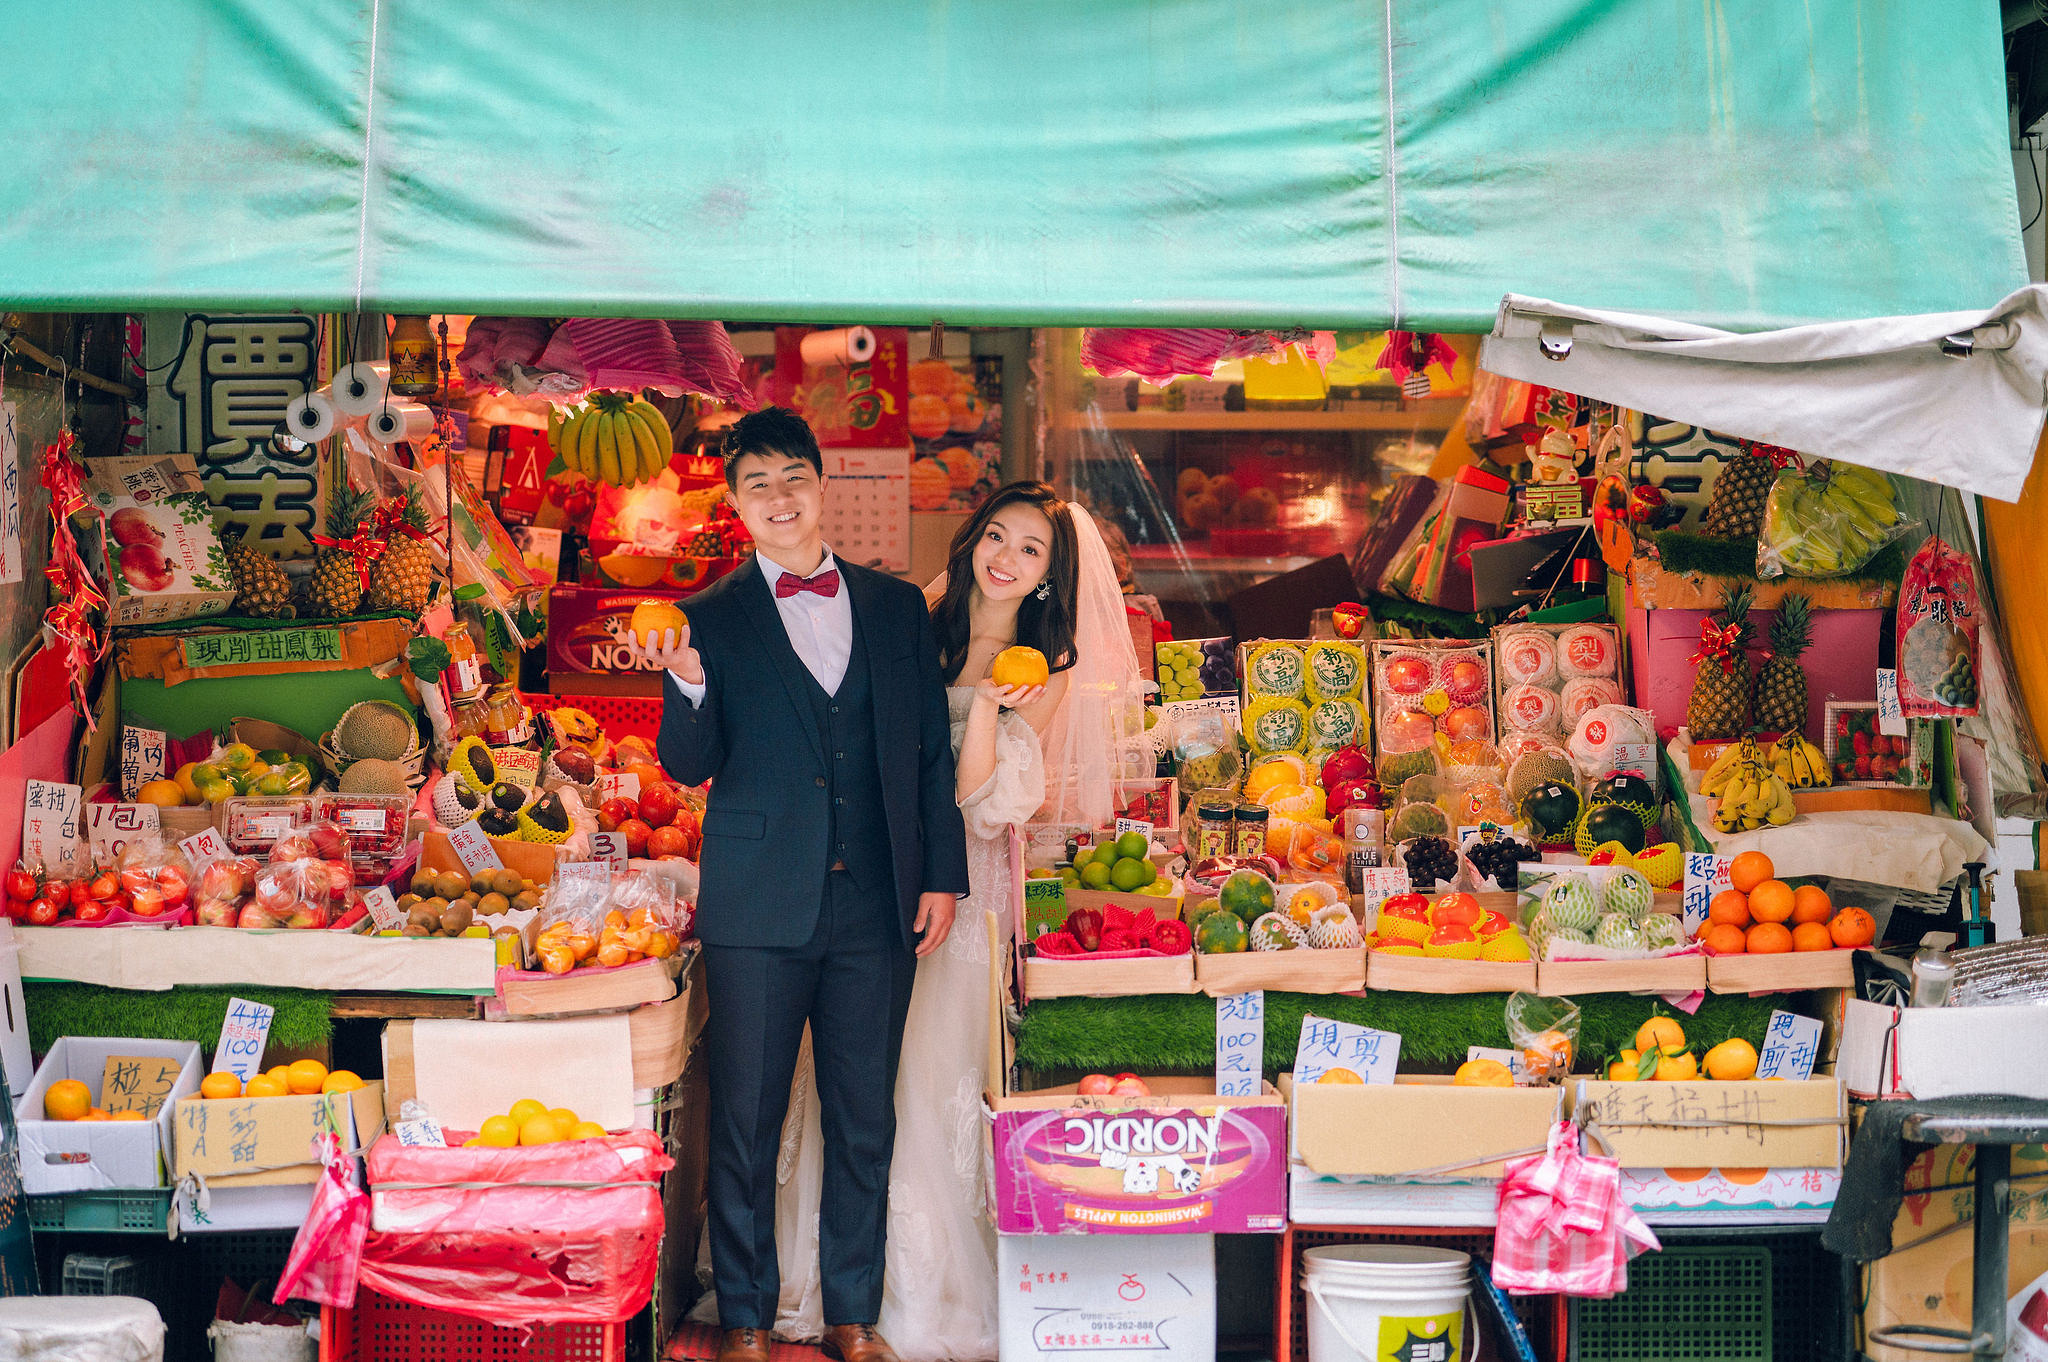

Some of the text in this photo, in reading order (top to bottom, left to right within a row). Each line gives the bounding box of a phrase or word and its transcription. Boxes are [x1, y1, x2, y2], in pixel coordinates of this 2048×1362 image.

[172, 522, 197, 572] PEACHES
[196, 630, 338, 662] 現削甜鳳梨
[1573, 638, 1600, 664] 梨
[28, 782, 66, 812] 蜜柑
[92, 804, 144, 831] 1包
[594, 834, 617, 856] 3
[1687, 854, 1717, 921] 超甜
[224, 1038, 259, 1056] 100
[1219, 1032, 1257, 1053] 100
[1064, 1116, 1221, 1154] NORDIC
[1800, 1169, 1823, 1193] 桔
[1074, 1203, 1205, 1225] WASHINGTON APPLES
[1036, 1271, 1069, 1284] 百香果
